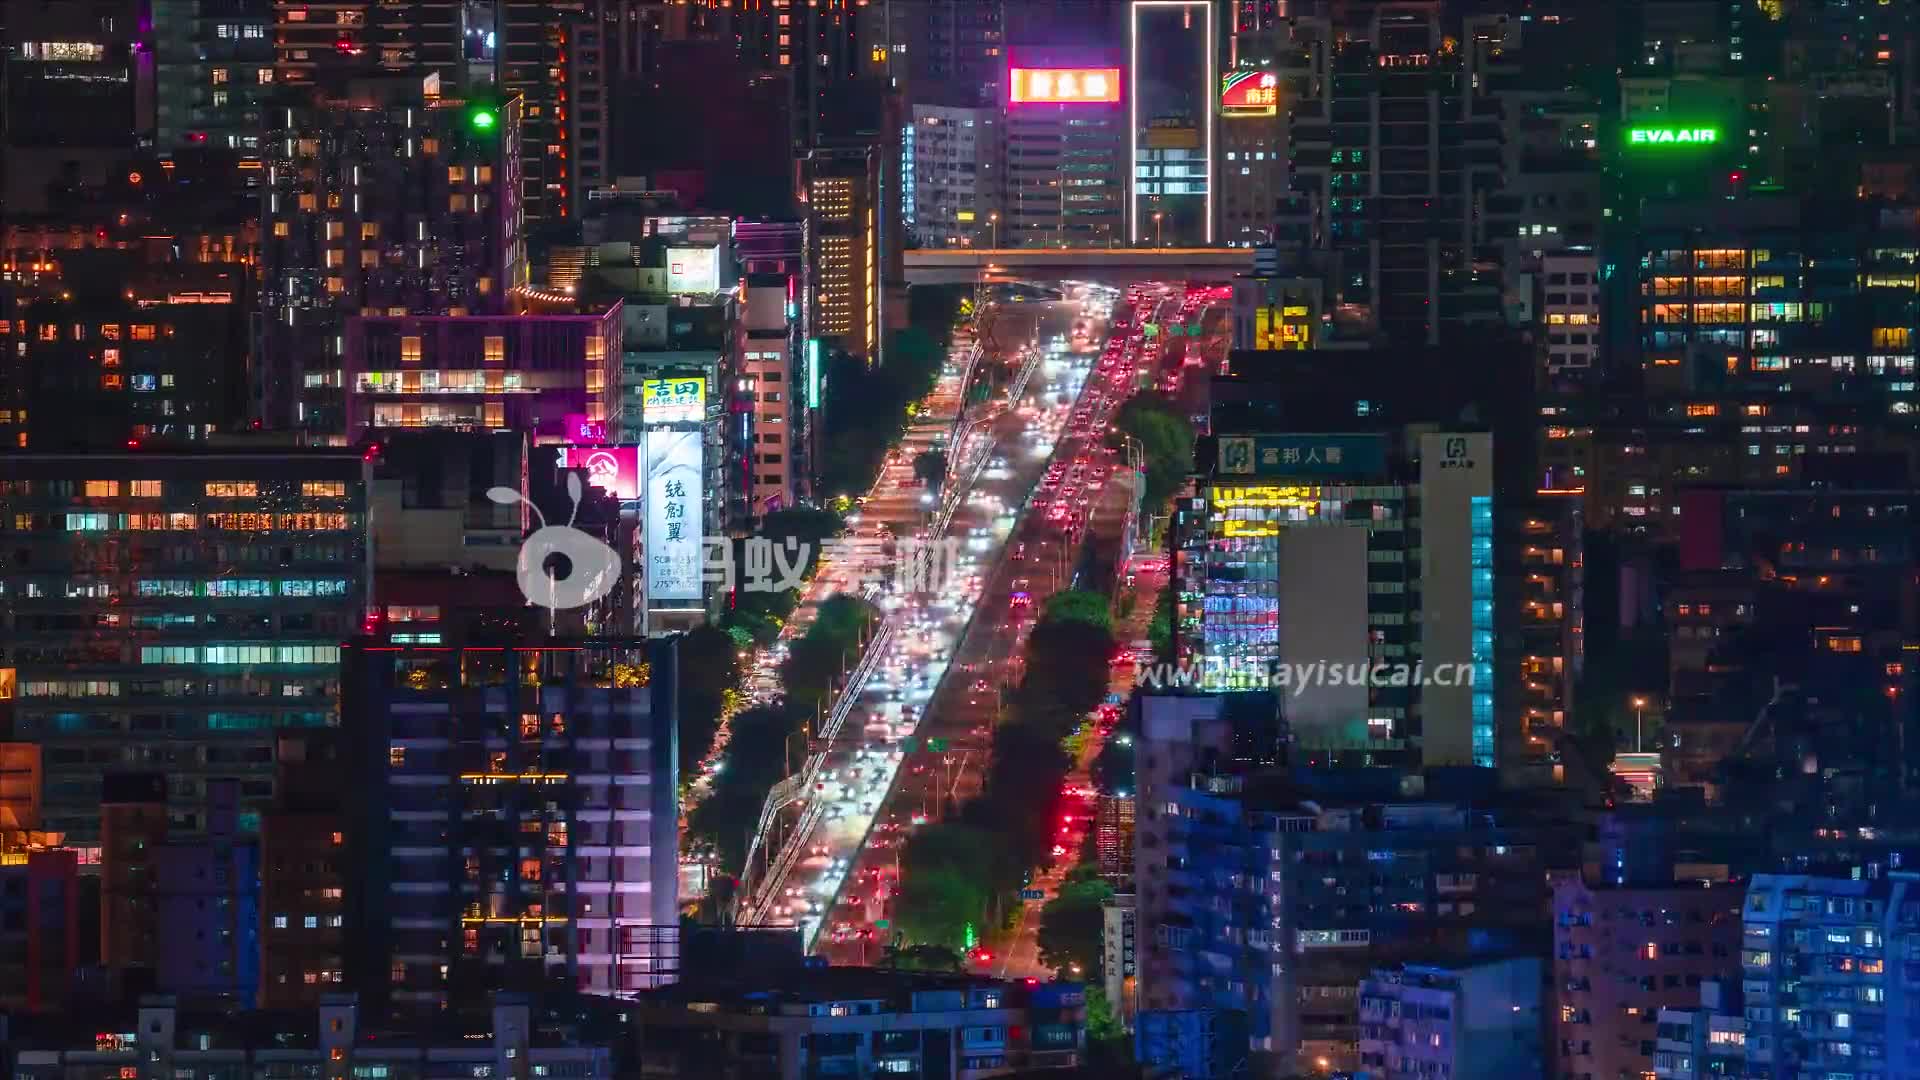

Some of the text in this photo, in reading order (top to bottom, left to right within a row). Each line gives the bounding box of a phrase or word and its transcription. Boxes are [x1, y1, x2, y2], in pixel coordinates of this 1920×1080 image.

[1631, 129, 1715, 142] EVA AIR
[647, 378, 699, 397] 吉田
[664, 479, 686, 543] 統創翼
